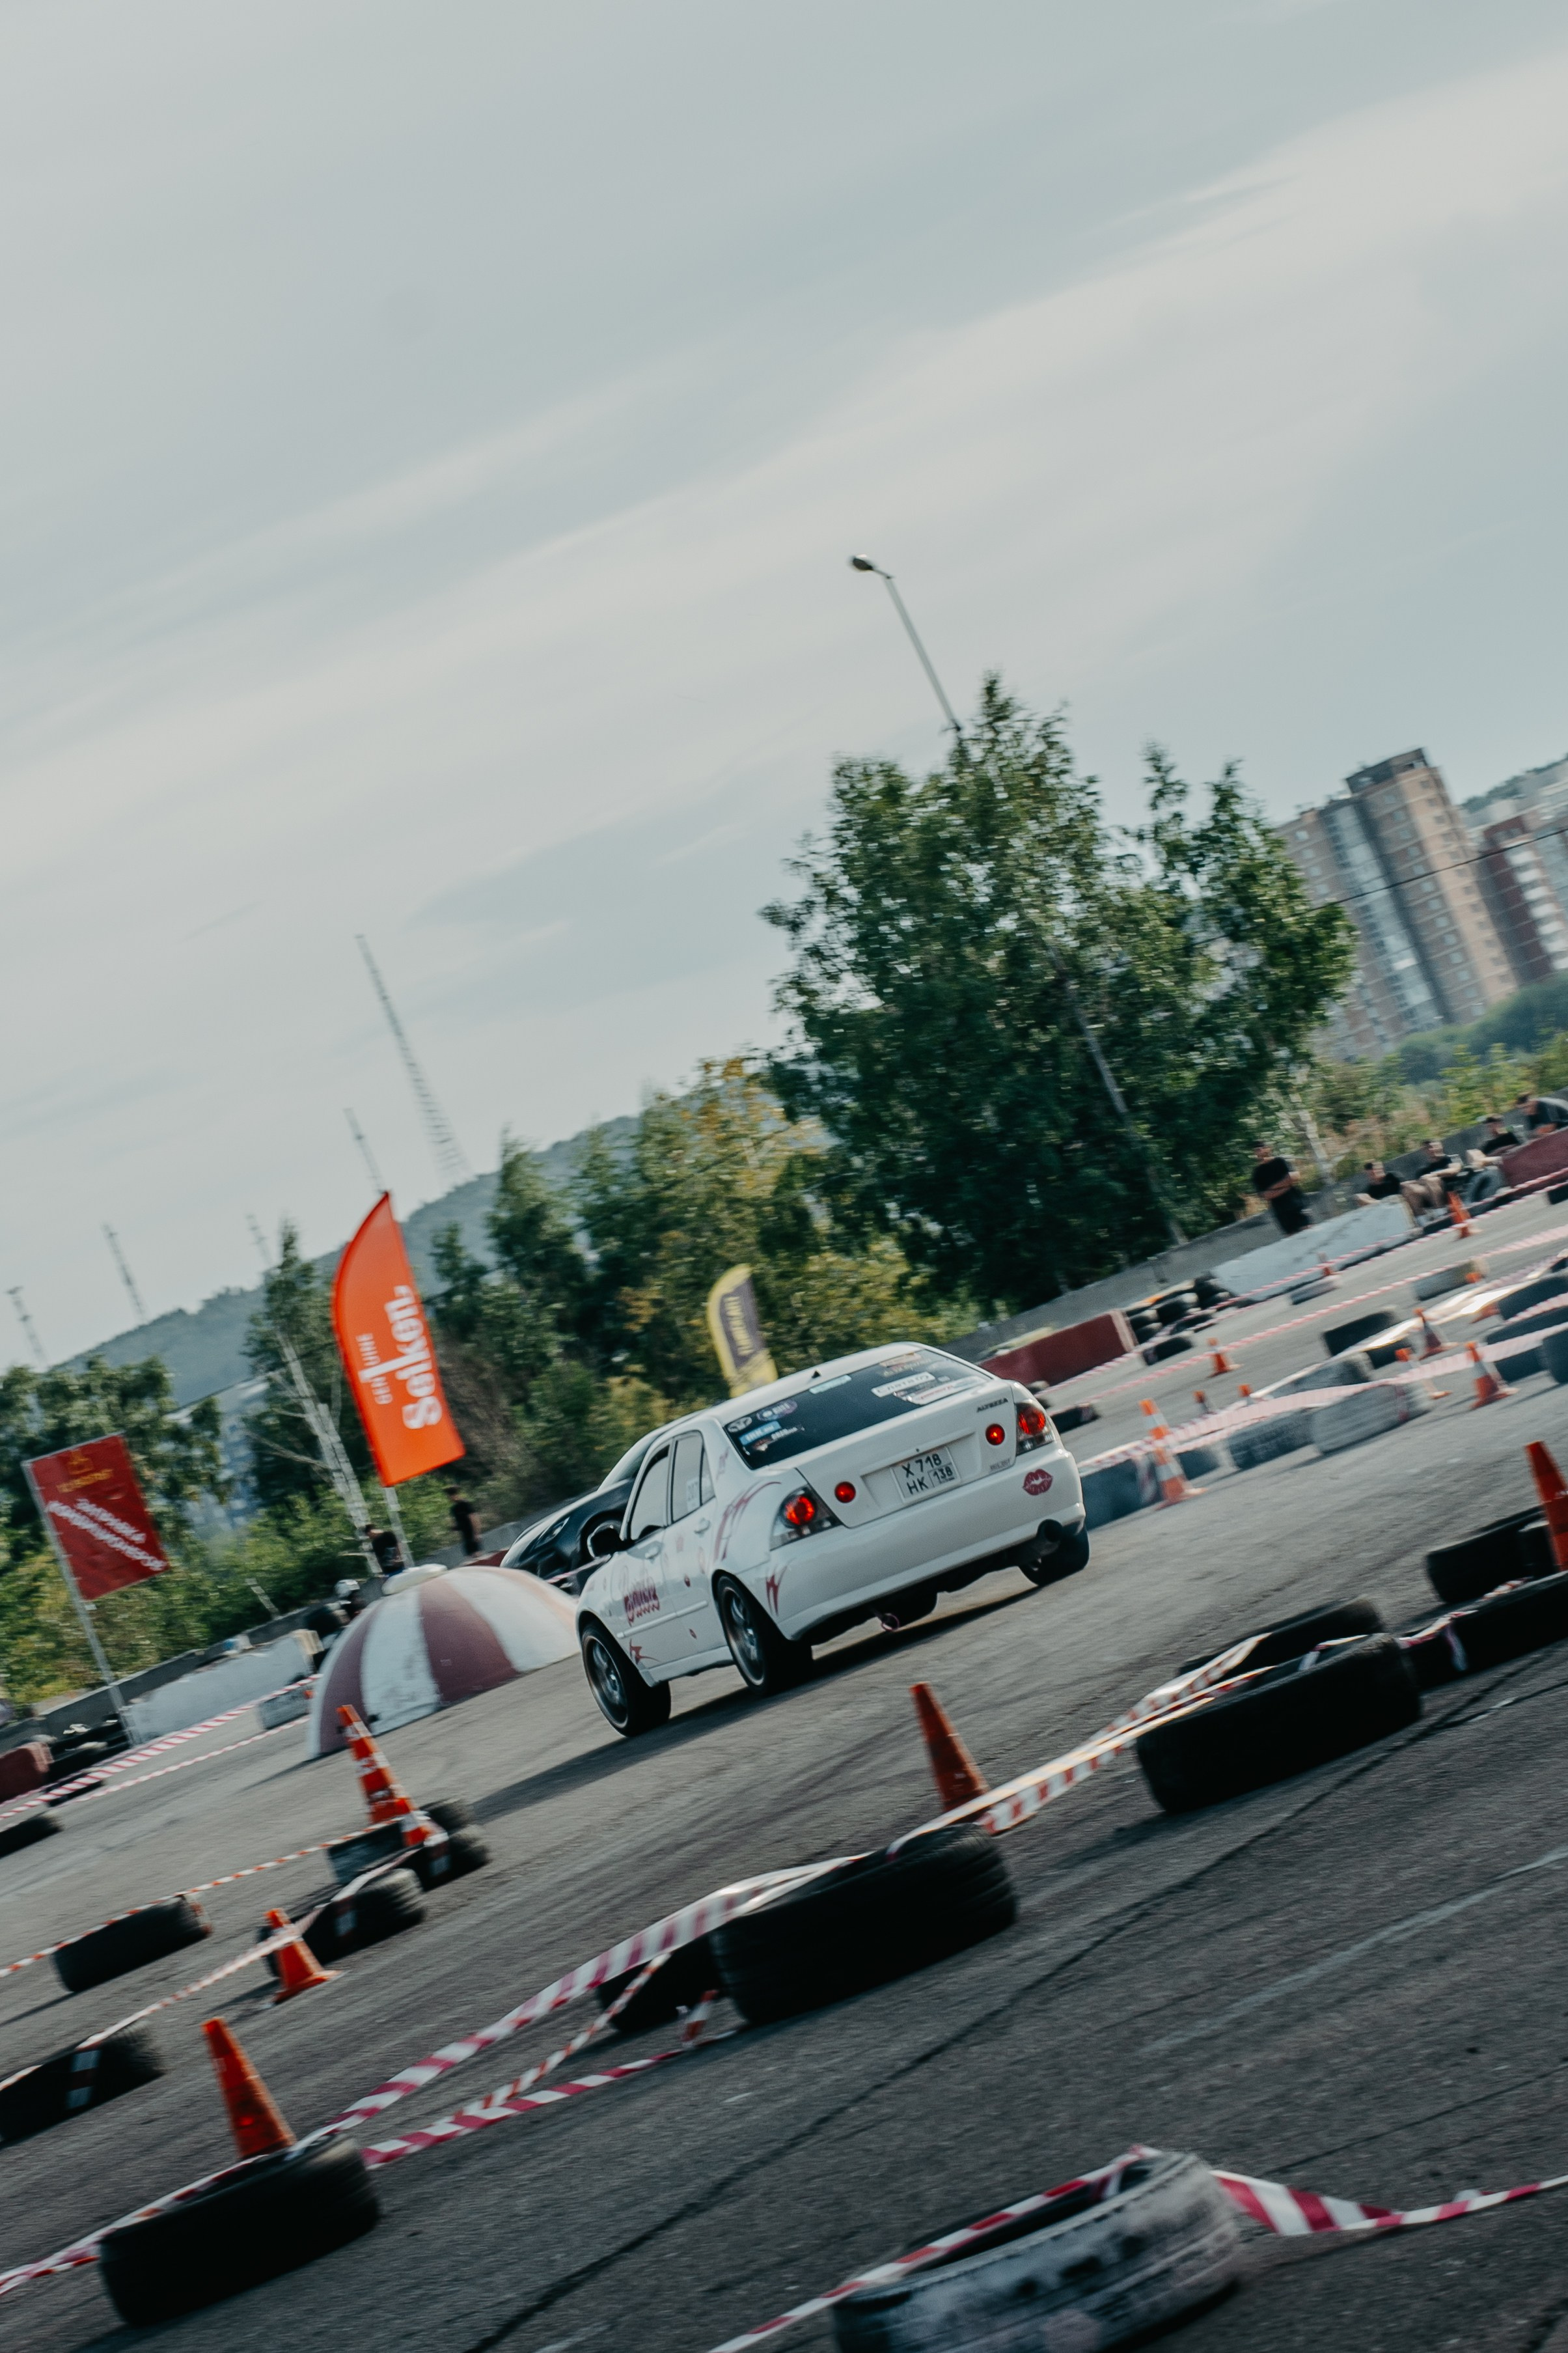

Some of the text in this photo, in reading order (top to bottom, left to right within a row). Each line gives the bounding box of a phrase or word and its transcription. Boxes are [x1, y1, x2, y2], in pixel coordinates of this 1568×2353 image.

[915, 1453, 942, 1472] 718
[906, 1477, 928, 1495] HK
[933, 1468, 953, 1482] 138
